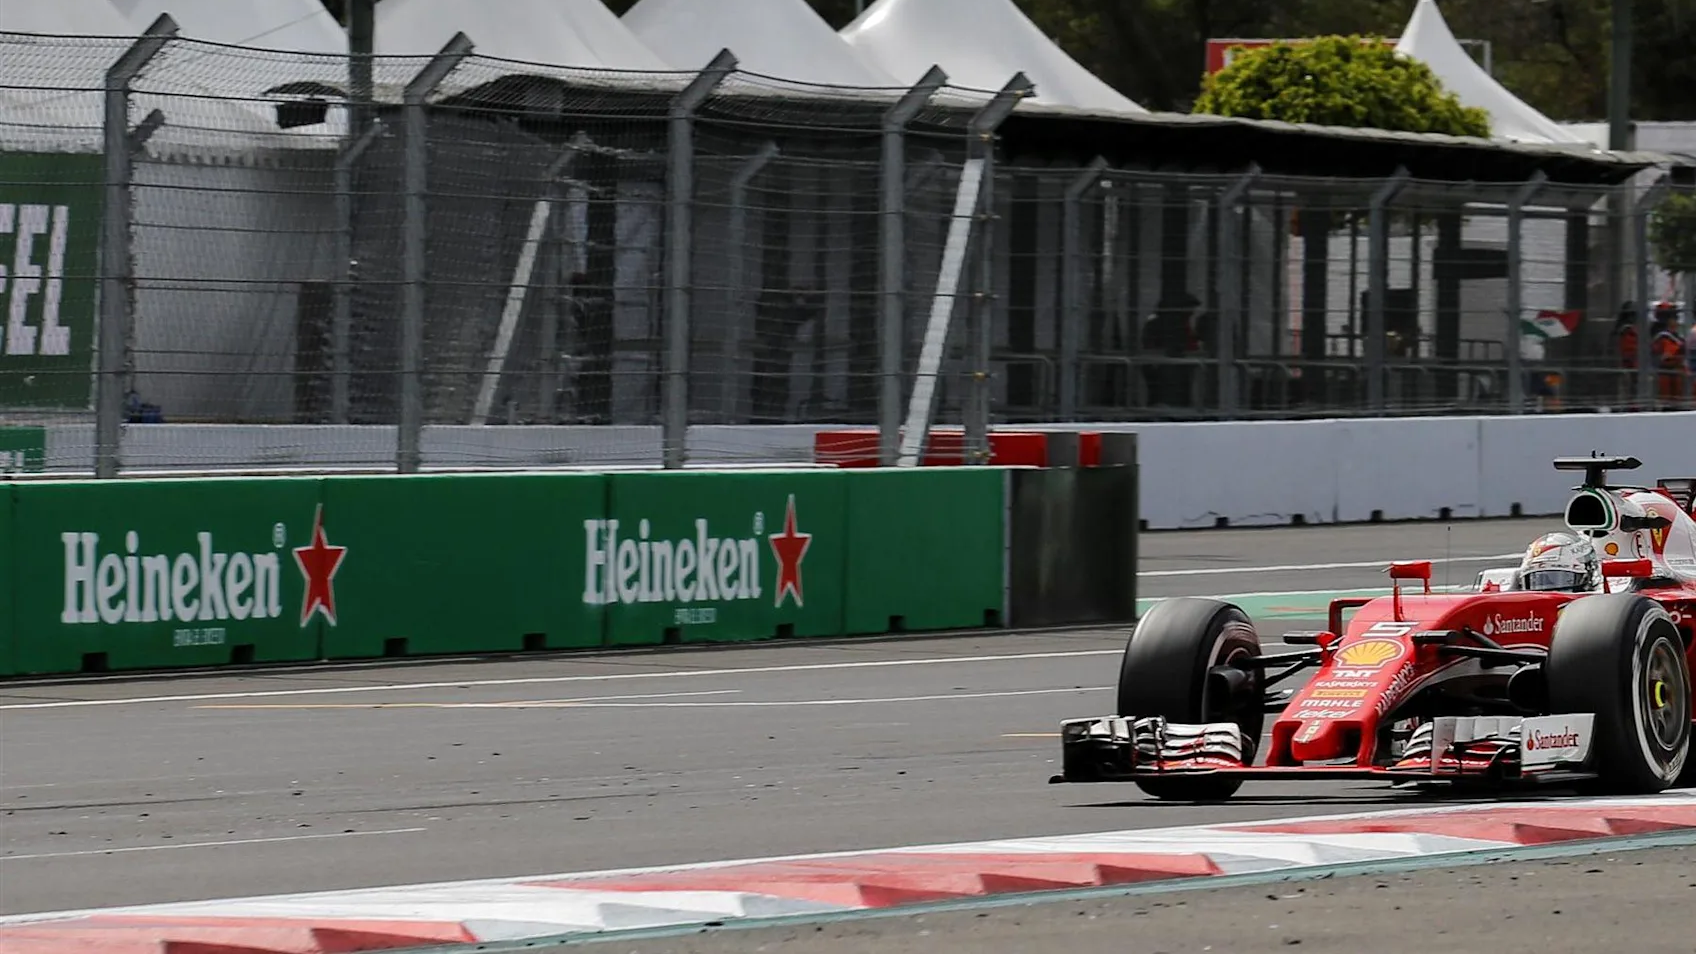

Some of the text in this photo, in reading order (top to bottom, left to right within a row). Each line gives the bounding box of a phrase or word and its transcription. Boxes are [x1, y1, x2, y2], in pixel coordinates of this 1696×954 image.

[582, 517, 763, 604] Heineken
[60, 530, 282, 625] Heineken
[1360, 621, 1420, 637] 5
[1494, 609, 1545, 635] Santander
[1331, 669, 1381, 679] TNT
[1299, 699, 1364, 707] MAHLE
[1535, 726, 1579, 750] Santander
